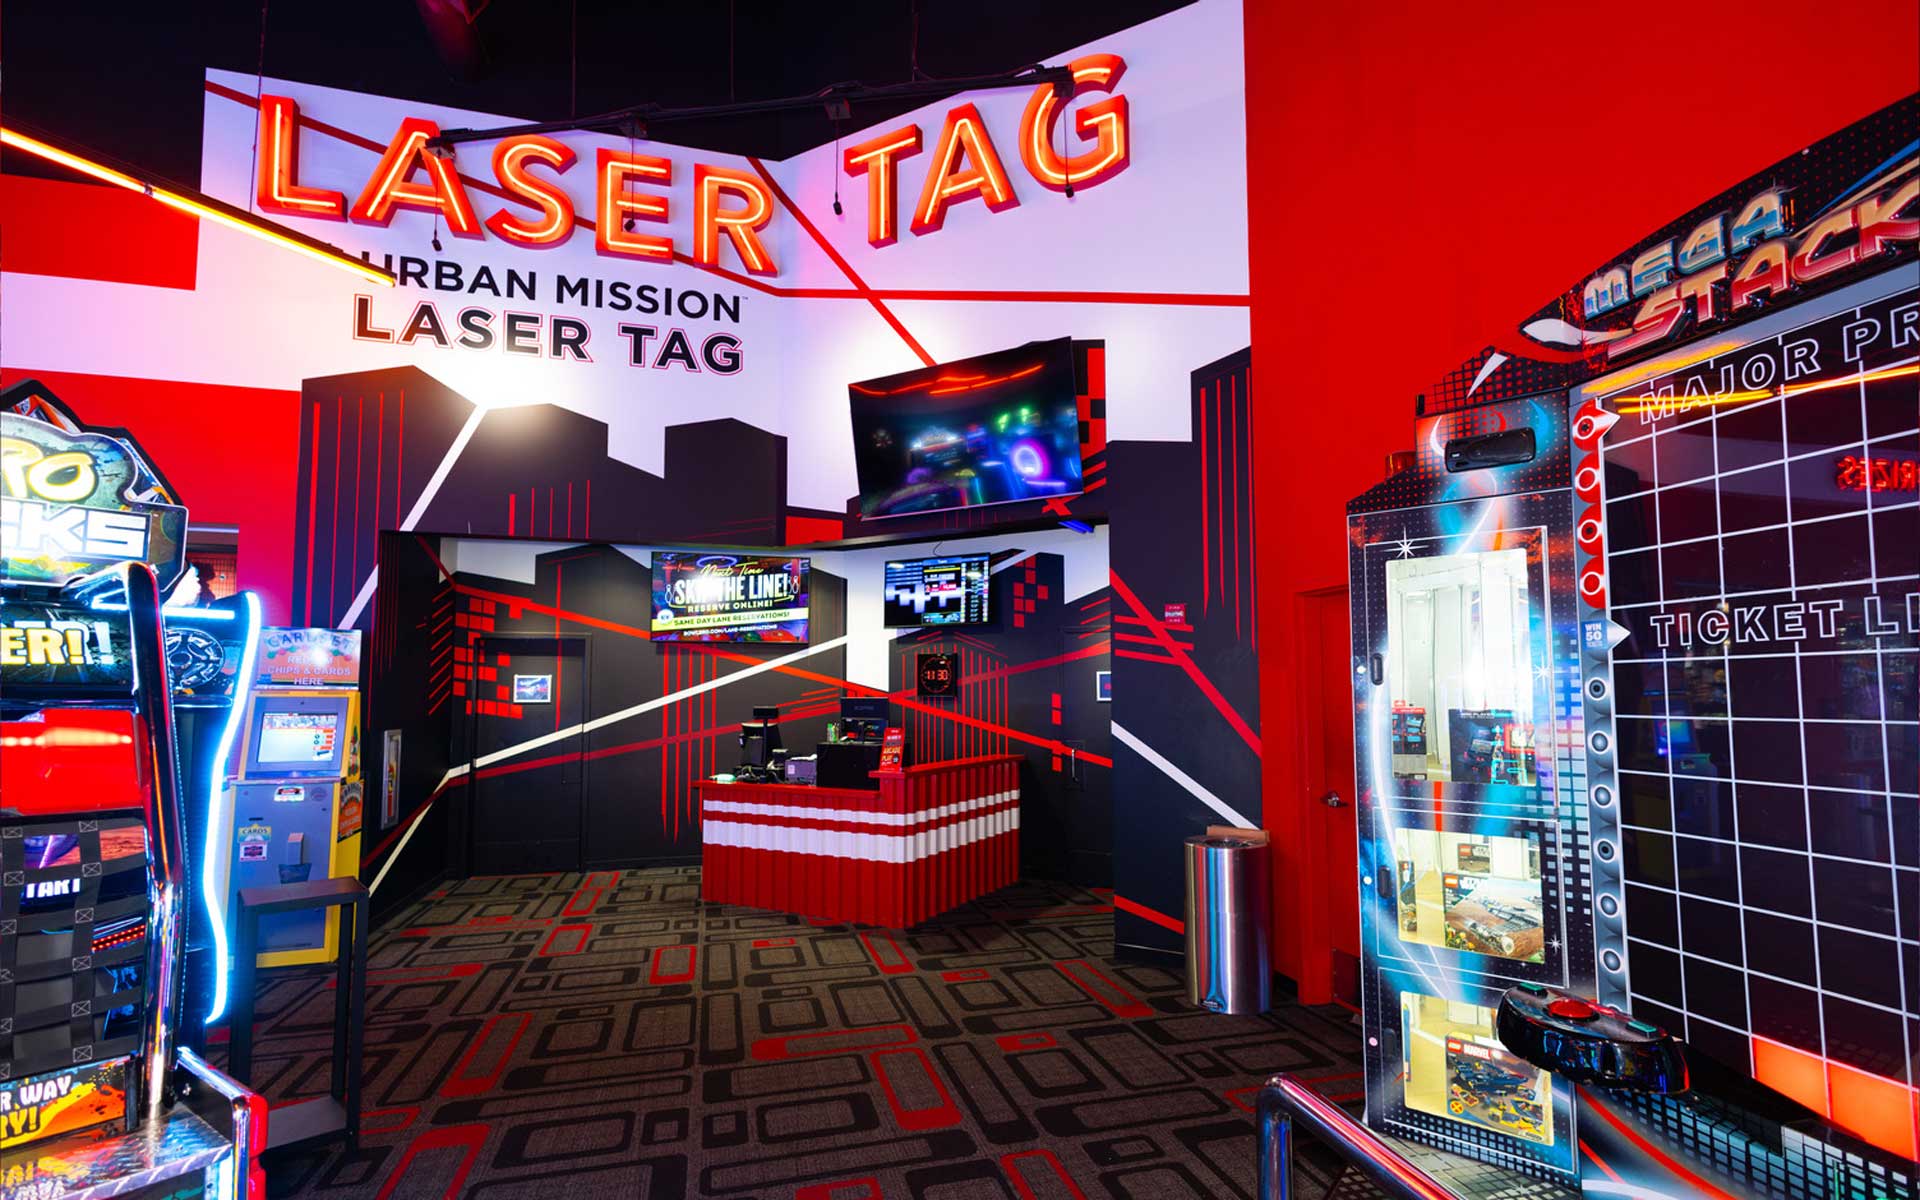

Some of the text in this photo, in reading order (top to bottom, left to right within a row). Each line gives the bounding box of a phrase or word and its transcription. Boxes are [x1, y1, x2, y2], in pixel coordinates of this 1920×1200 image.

[257, 53, 1130, 277] LASER TAG
[1584, 192, 1788, 319] MEGA
[1607, 176, 1919, 360] STACK
[556, 275, 740, 323] MISSION
[353, 293, 743, 376] LASER TAG
[1640, 338, 1821, 425] MAJOR
[674, 577, 712, 605] SK
[749, 572, 788, 600] LINE!
[674, 611, 790, 626] SAME DAY LANE RESERVATIONS!
[687, 599, 773, 613] RESERVE ONLINE!
[1585, 622, 1602, 631] WIN
[1586, 630, 1602, 642] 50
[1650, 600, 1843, 647] TICKET
[267, 665, 300, 675] CHIPS
[313, 666, 352, 676] CARDS
[294, 677, 324, 686] HERE
[20, 1075, 72, 1106] WAY
